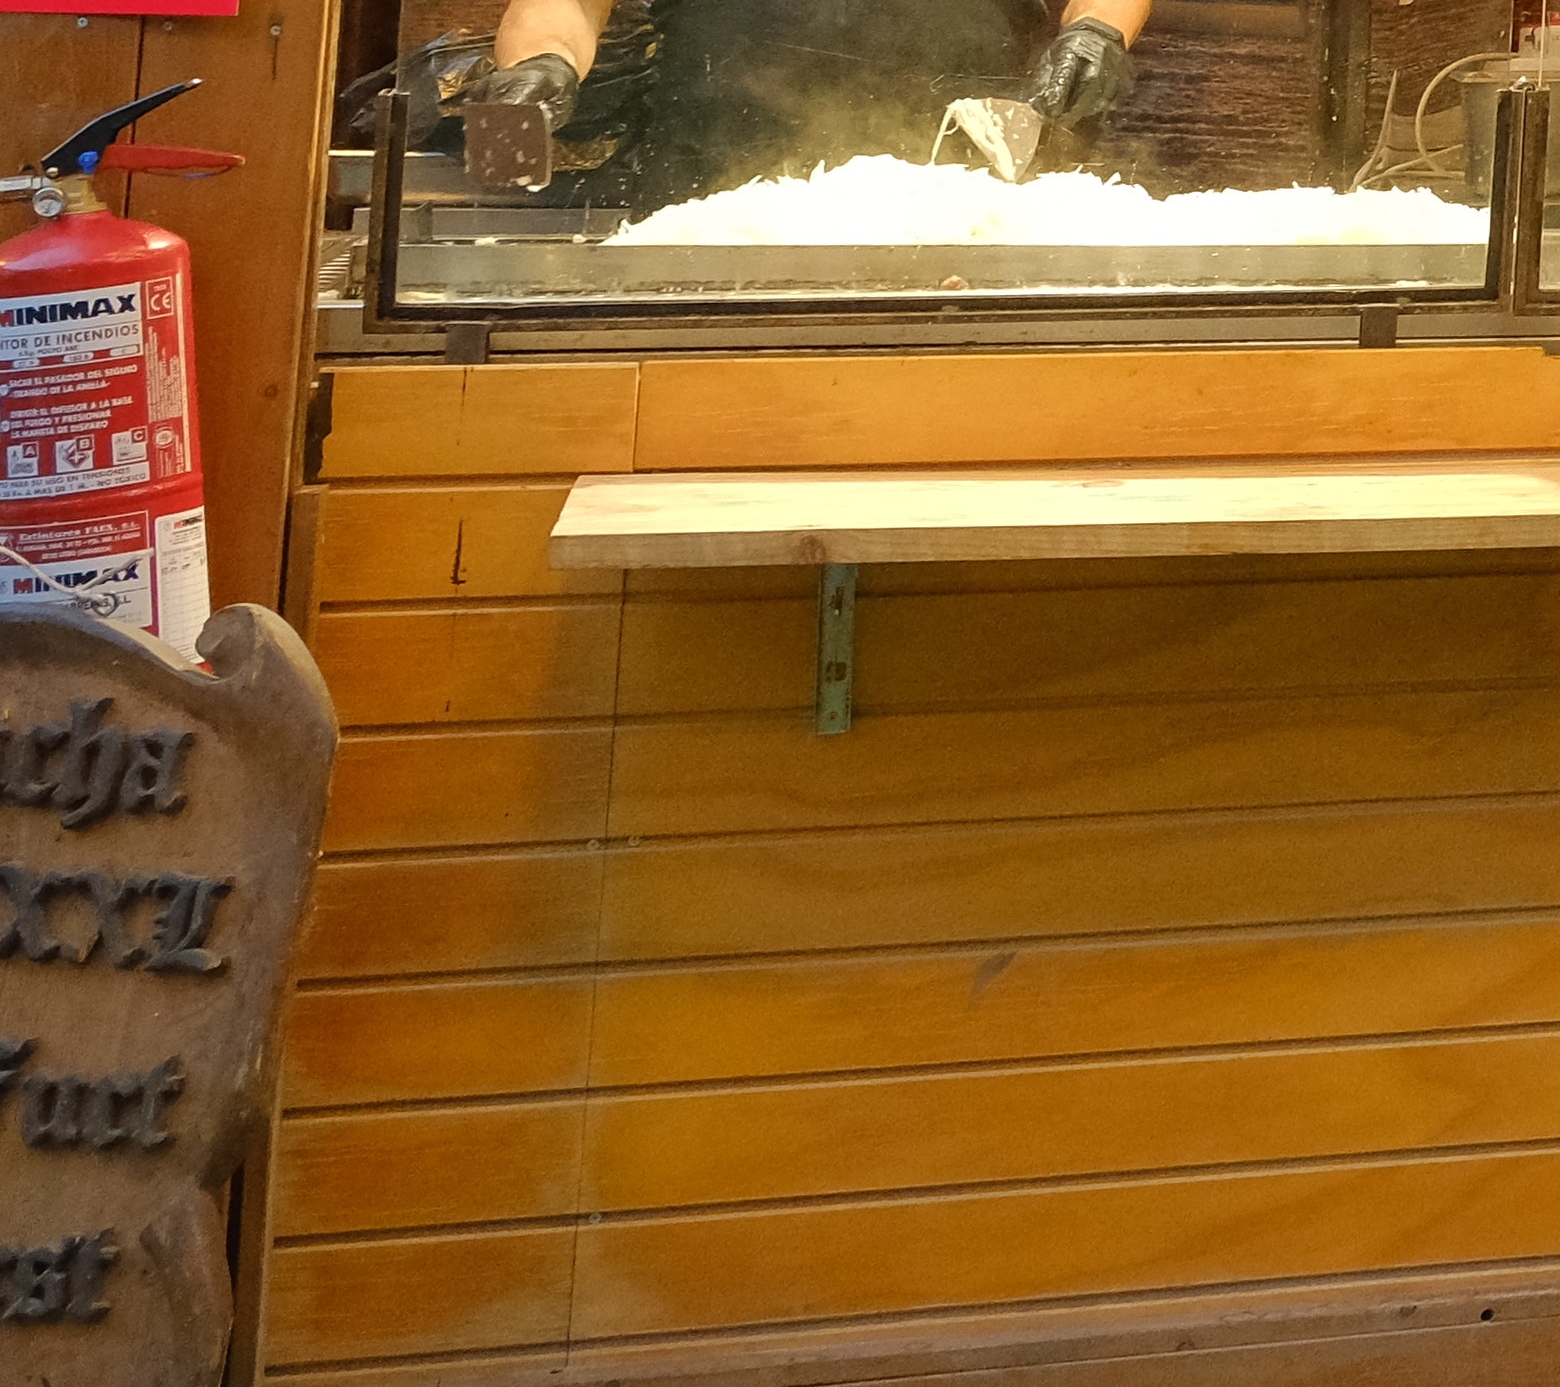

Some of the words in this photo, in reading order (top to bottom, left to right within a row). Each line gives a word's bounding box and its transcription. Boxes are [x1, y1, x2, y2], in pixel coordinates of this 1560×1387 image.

[34, 335, 53, 348] DE
[56, 323, 140, 345] INCENDIOS
[24, 445, 36, 457] A
[79, 438, 91, 449] B
[133, 429, 144, 441] C
